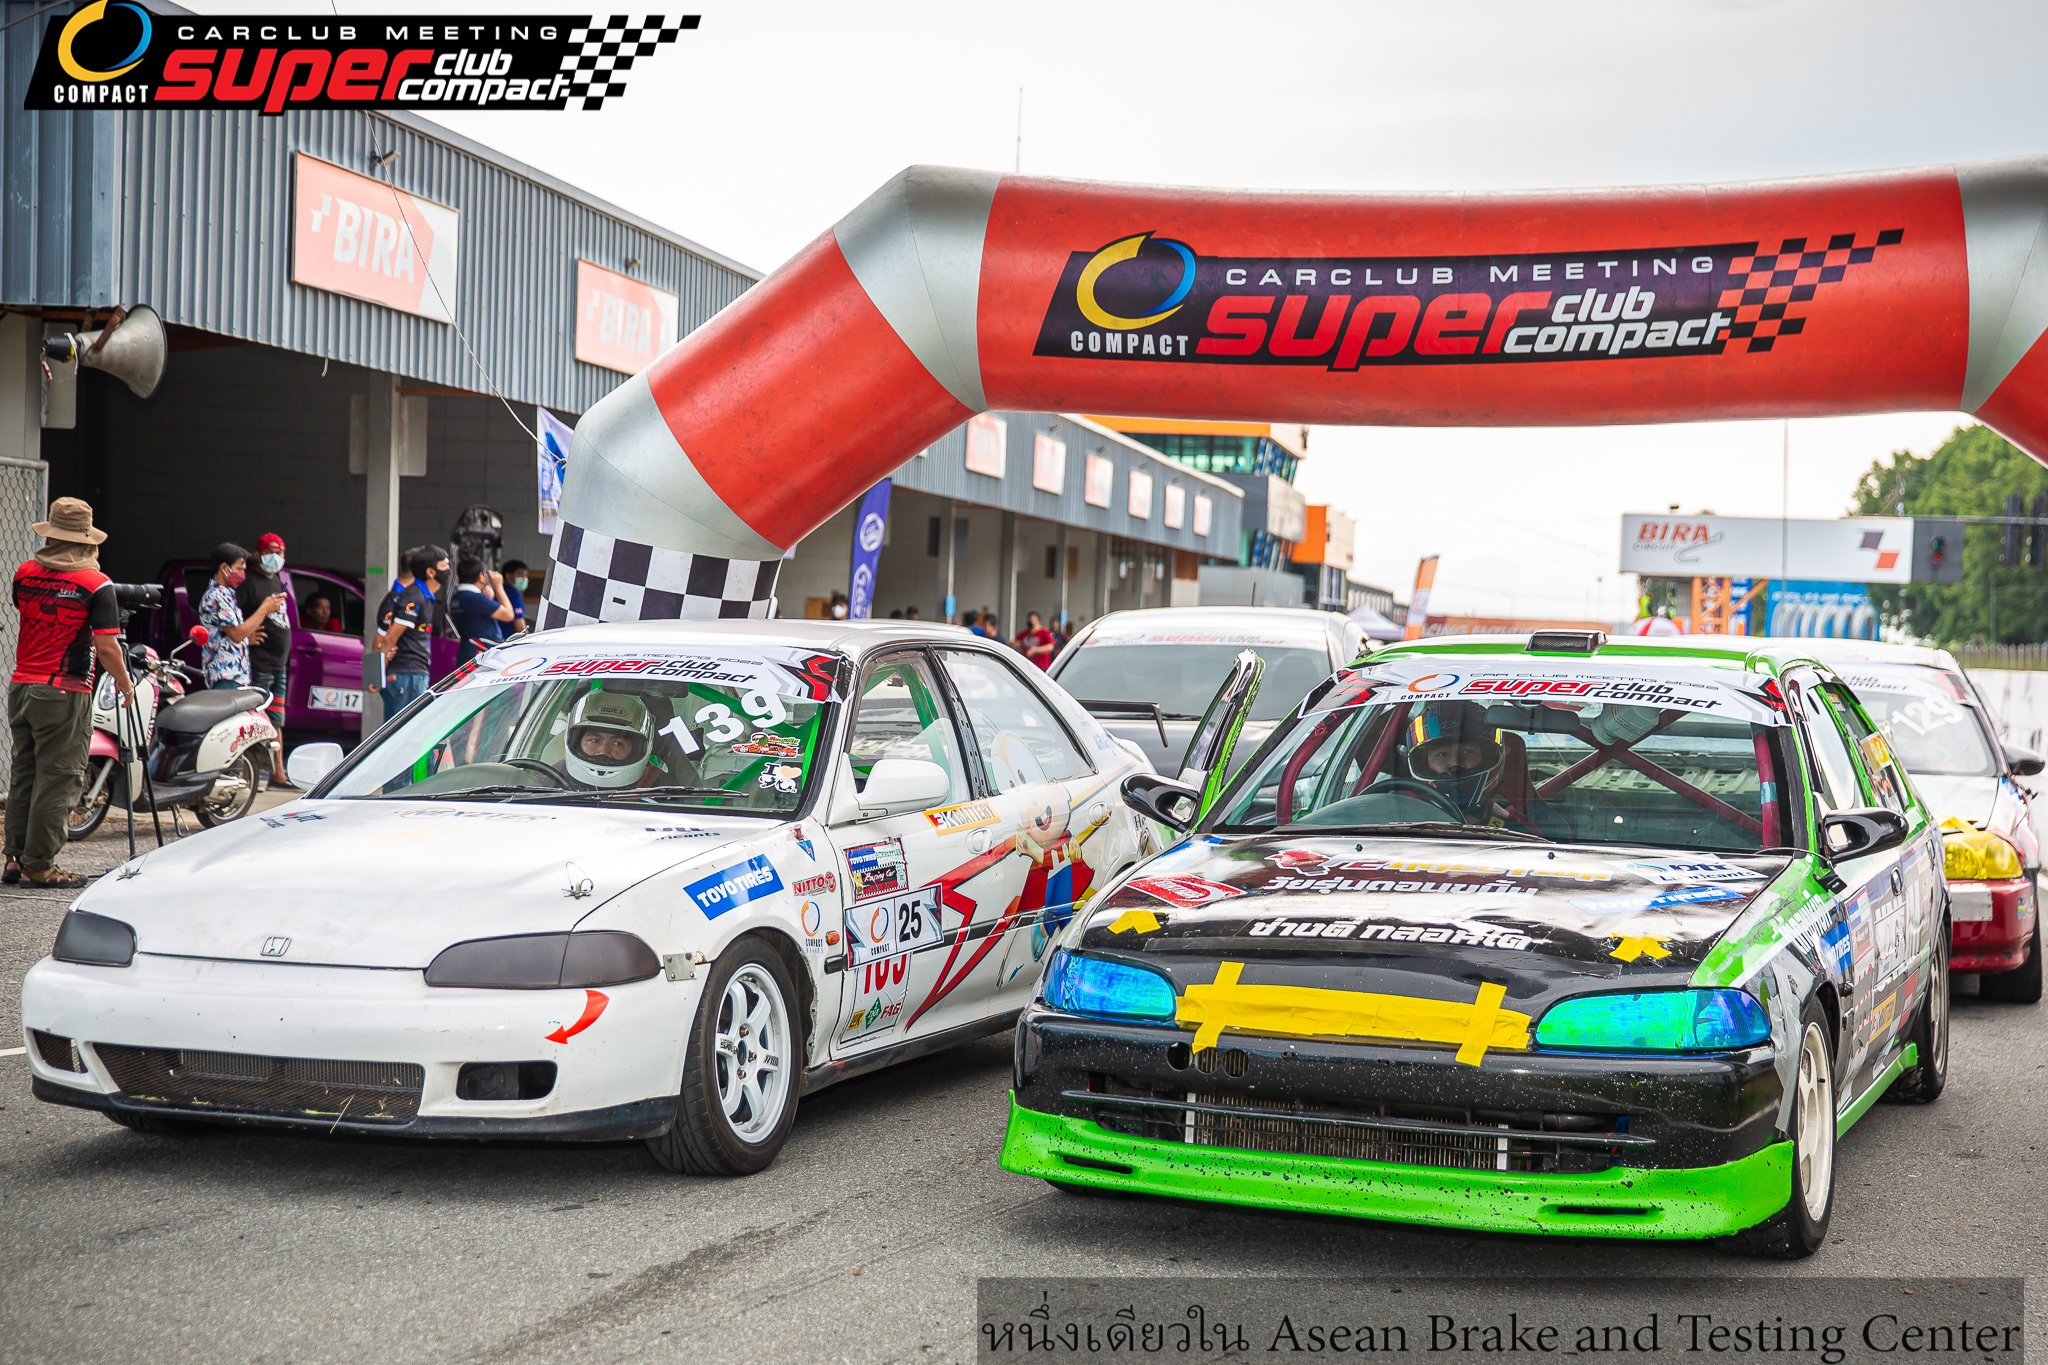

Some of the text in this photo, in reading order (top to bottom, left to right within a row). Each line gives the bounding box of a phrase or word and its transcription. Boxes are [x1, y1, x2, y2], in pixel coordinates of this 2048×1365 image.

[332, 197, 416, 284] BIRA
[1225, 255, 1714, 287] CARCLUB MEETING
[1551, 285, 1656, 324] club
[598, 293, 652, 357] BIRA
[1195, 290, 1552, 370] super
[1503, 311, 1731, 356] compact
[1070, 330, 1189, 357] COMPACT
[1636, 522, 1711, 543] BIRA
[539, 658, 663, 677] super
[665, 659, 721, 671] club
[646, 668, 758, 683] compact
[1575, 673, 1658, 683] MEETING
[1400, 692, 1451, 701] COMPACT
[1459, 678, 1608, 698] super
[1610, 682, 1674, 695] club
[344, 693, 360, 708] 17
[1592, 690, 1723, 709] compact
[657, 688, 789, 756] 139
[792, 876, 825, 896] NITTO
[898, 899, 922, 943] 25
[870, 943, 891, 957] COMPACT
